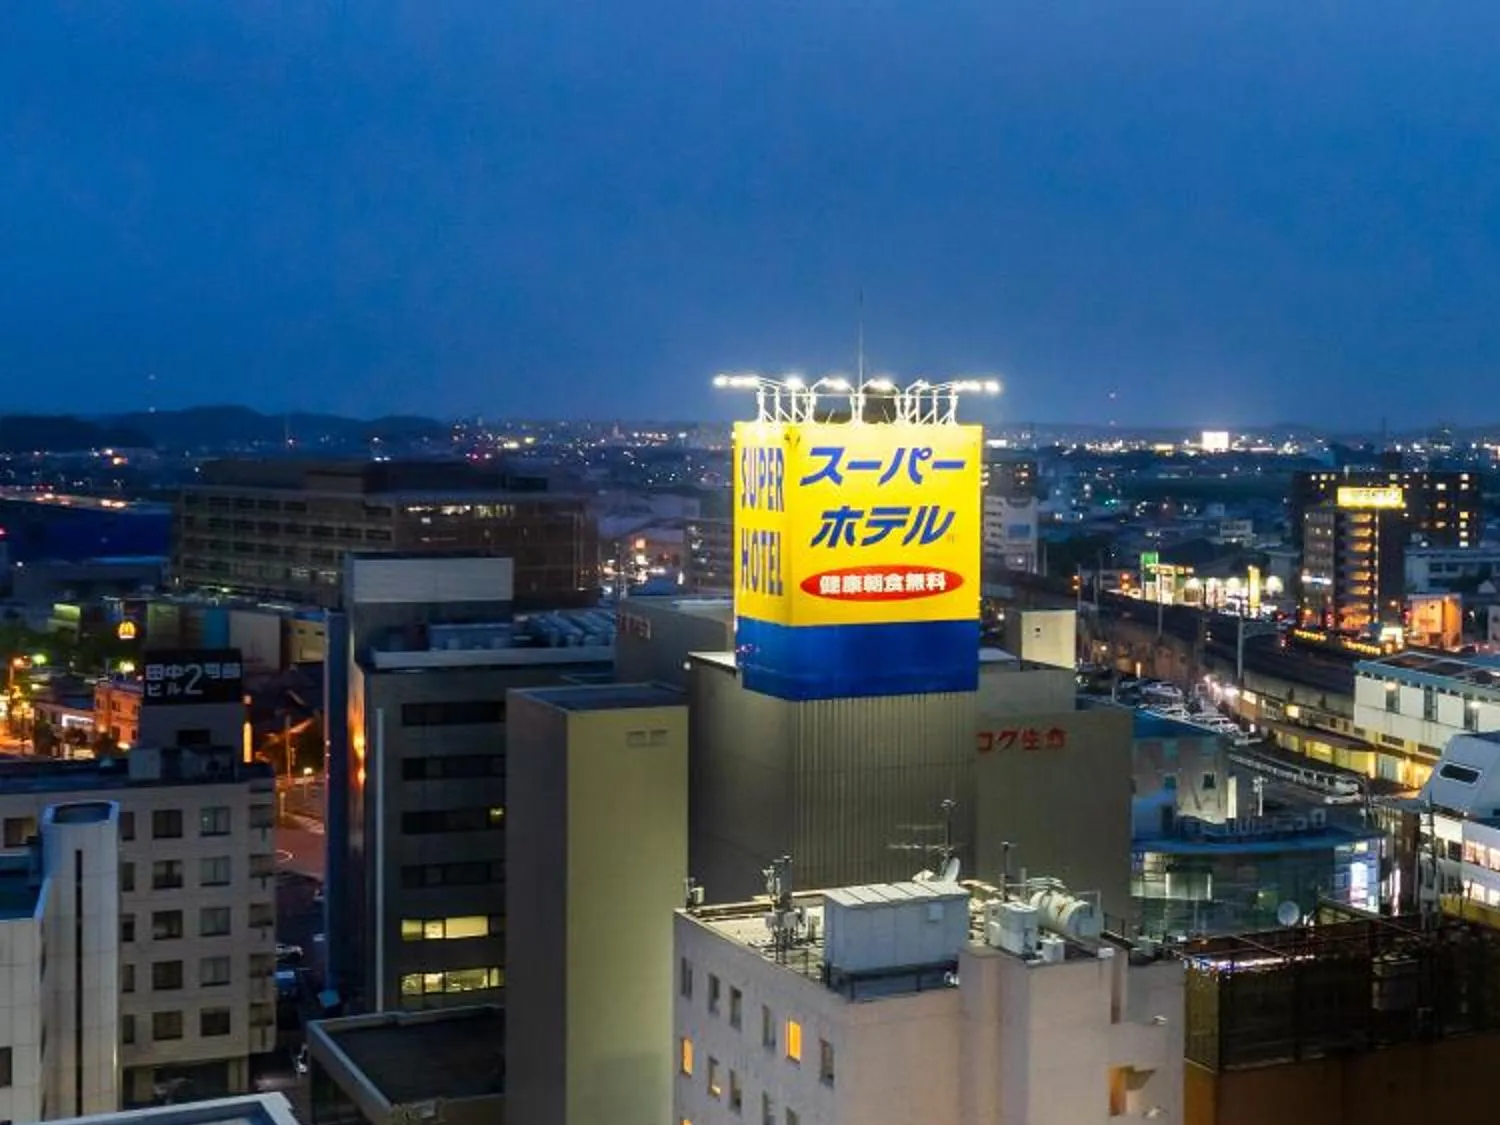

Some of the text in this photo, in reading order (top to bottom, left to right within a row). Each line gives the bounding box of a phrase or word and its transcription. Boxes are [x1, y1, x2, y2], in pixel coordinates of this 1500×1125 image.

[741, 447, 785, 512] SUPER
[799, 447, 967, 486] スーパー
[810, 505, 956, 548] ホテル
[741, 527, 784, 596] HOTEL
[819, 572, 946, 594] 健康朝食無料
